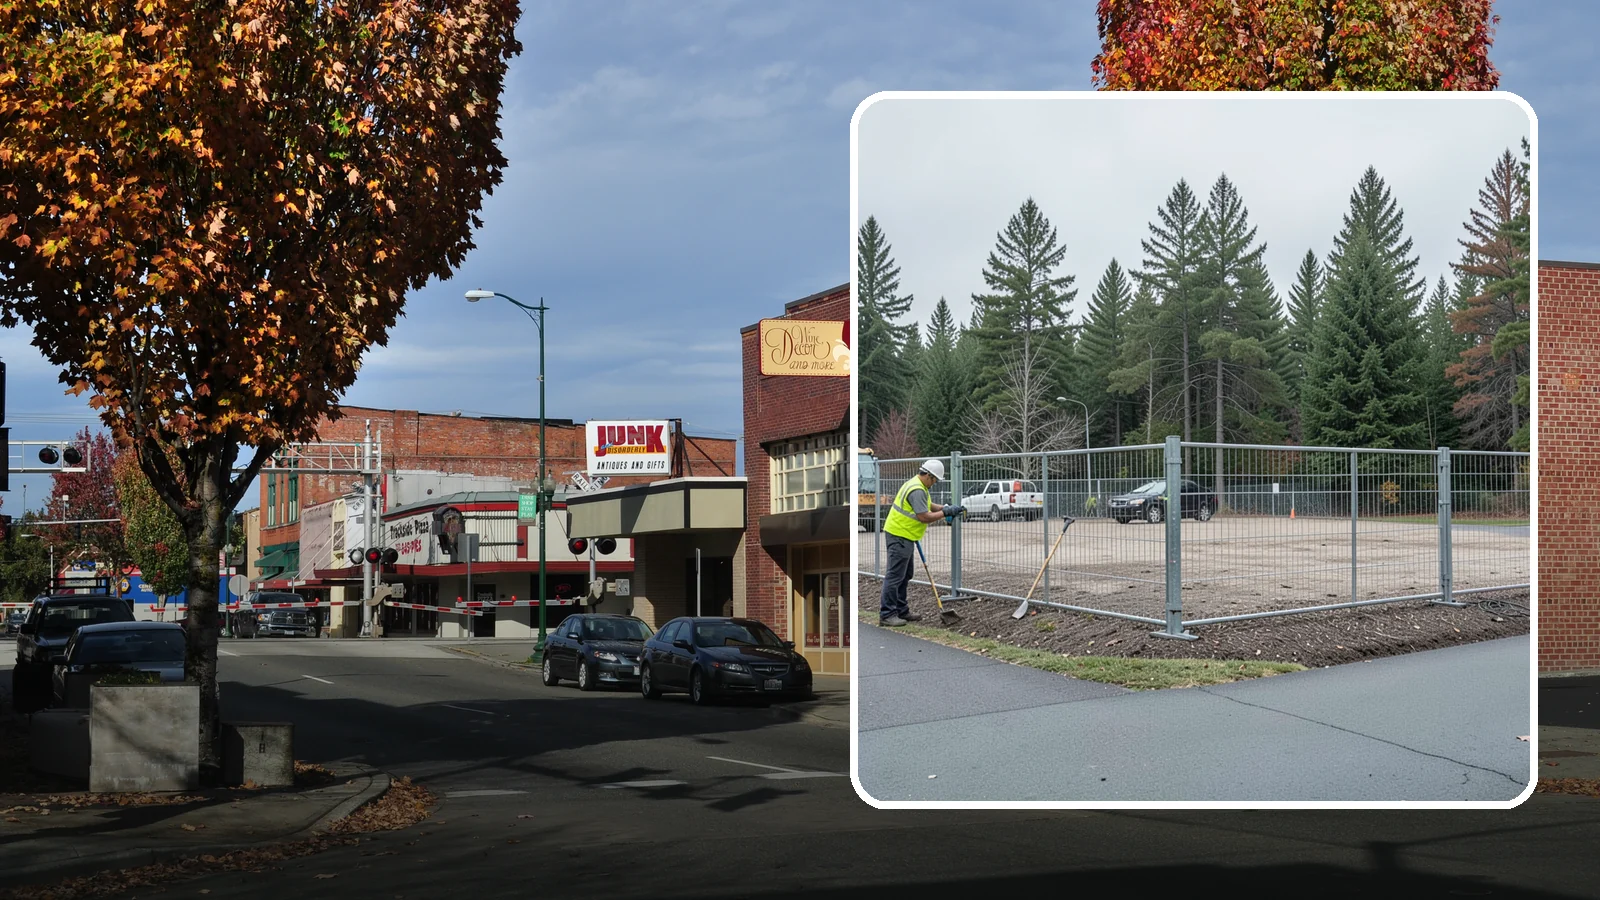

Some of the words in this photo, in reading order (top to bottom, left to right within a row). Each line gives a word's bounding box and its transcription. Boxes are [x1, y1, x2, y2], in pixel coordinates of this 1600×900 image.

[595, 425, 665, 457] JUNK
[607, 446, 646, 454] DISORDERLY
[597, 461, 628, 470] ANTIQUES
[631, 461, 644, 470] AND
[647, 460, 665, 469] GIFTS
[390, 521, 413, 540] Trackside
[414, 519, 429, 535] Pizza
